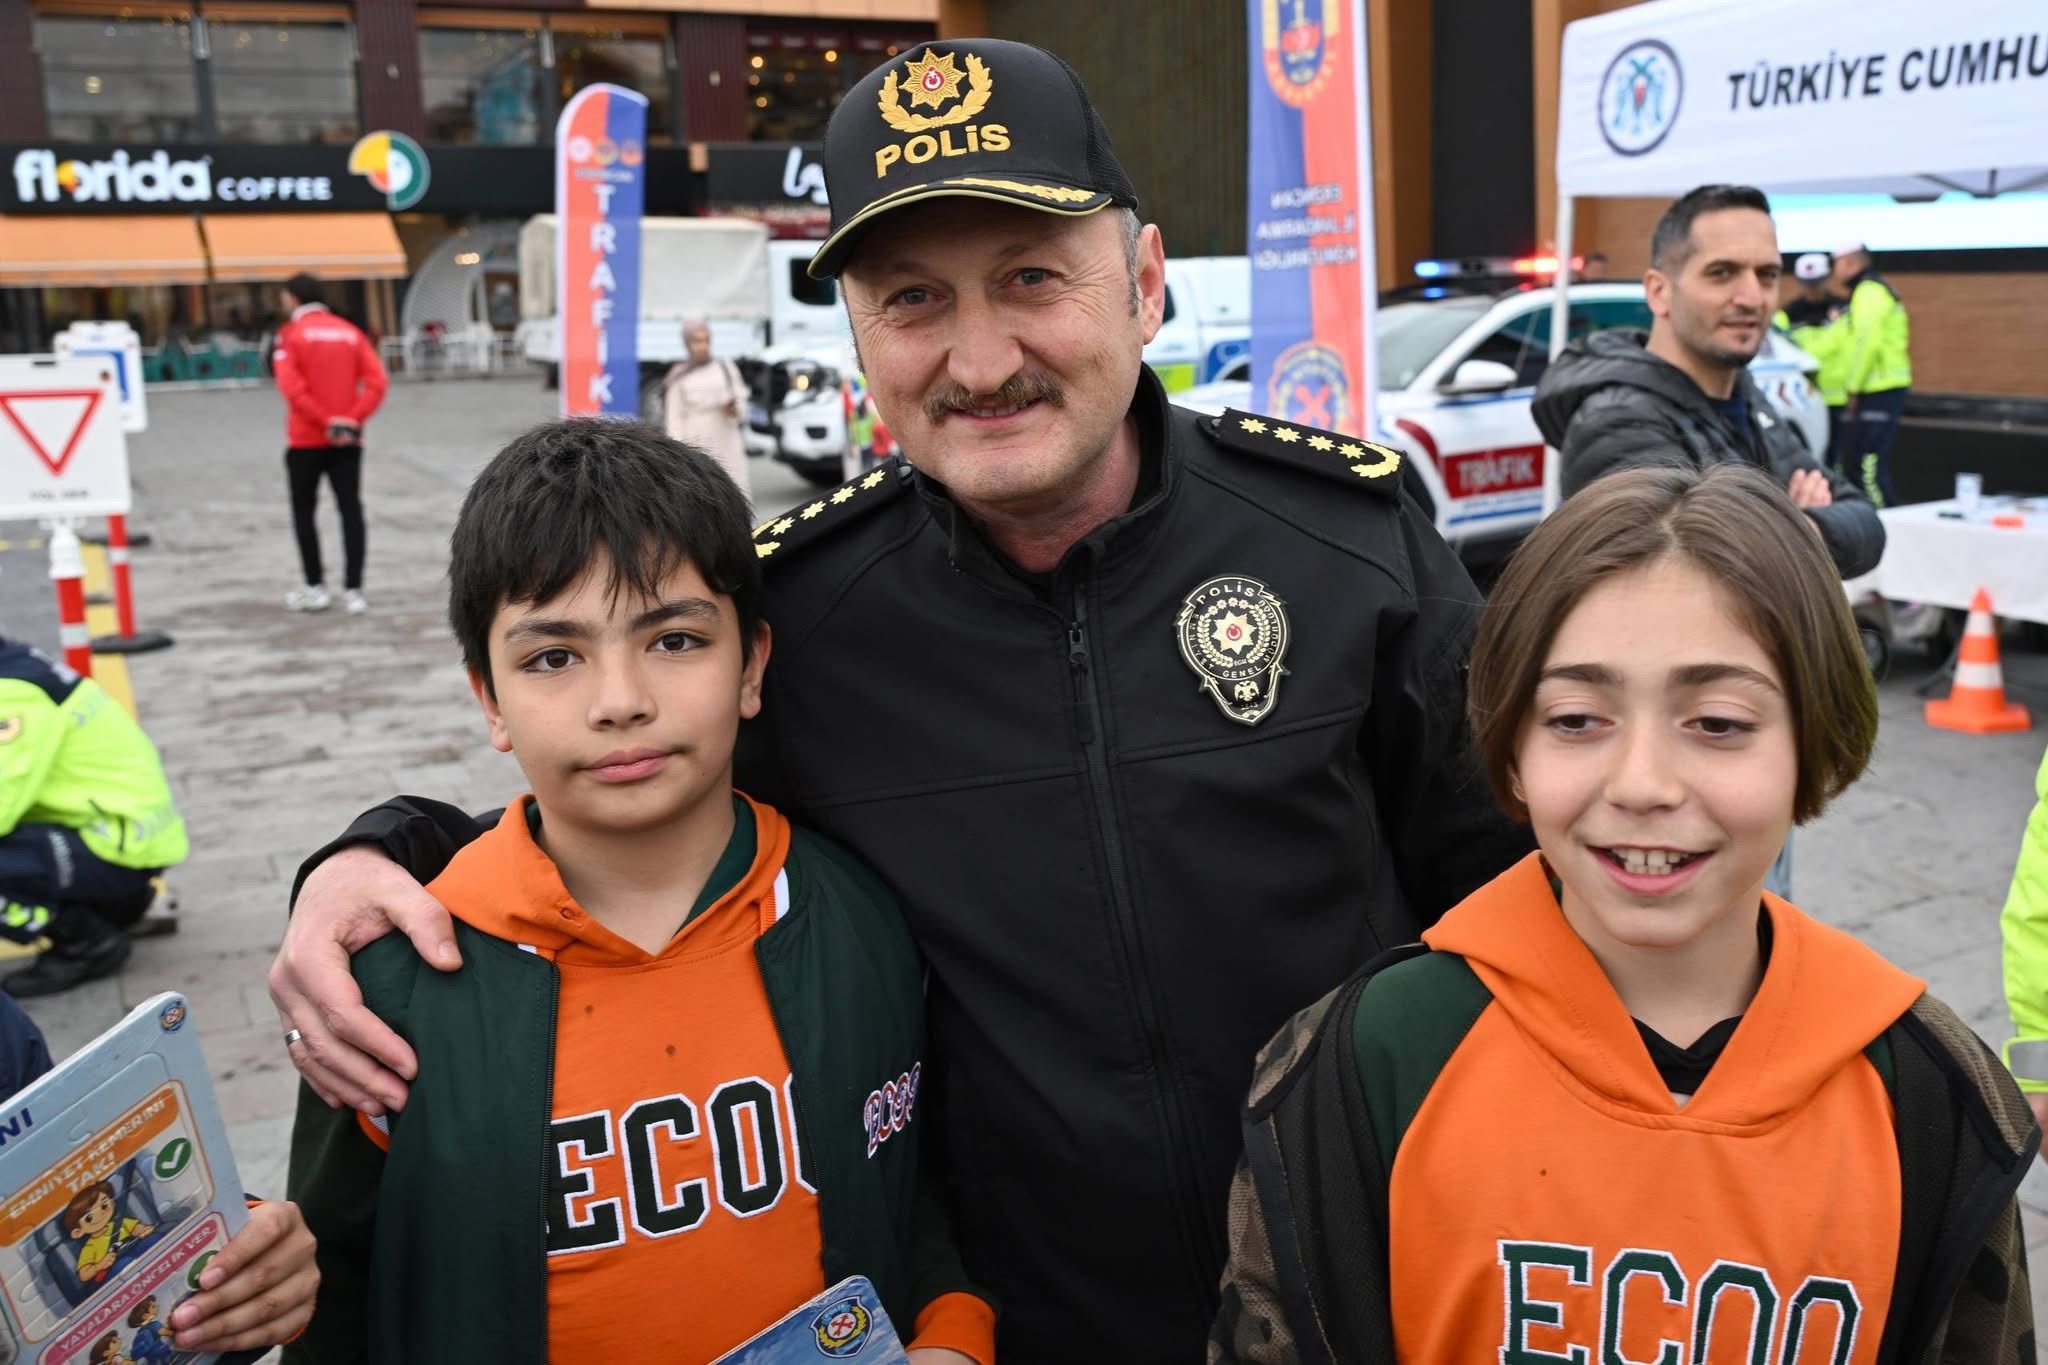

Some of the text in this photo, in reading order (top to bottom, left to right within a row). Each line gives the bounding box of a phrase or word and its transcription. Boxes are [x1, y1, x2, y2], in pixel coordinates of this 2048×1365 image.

[1728, 33, 2048, 110] TÜRKİYE CUMHU
[13, 149, 332, 202] florida COFFEE
[1196, 581, 1254, 605] POLİS
[1222, 665, 1261, 678] GENEL
[547, 1072, 818, 1256] ECO
[61, 1293, 130, 1351] YAYALARA
